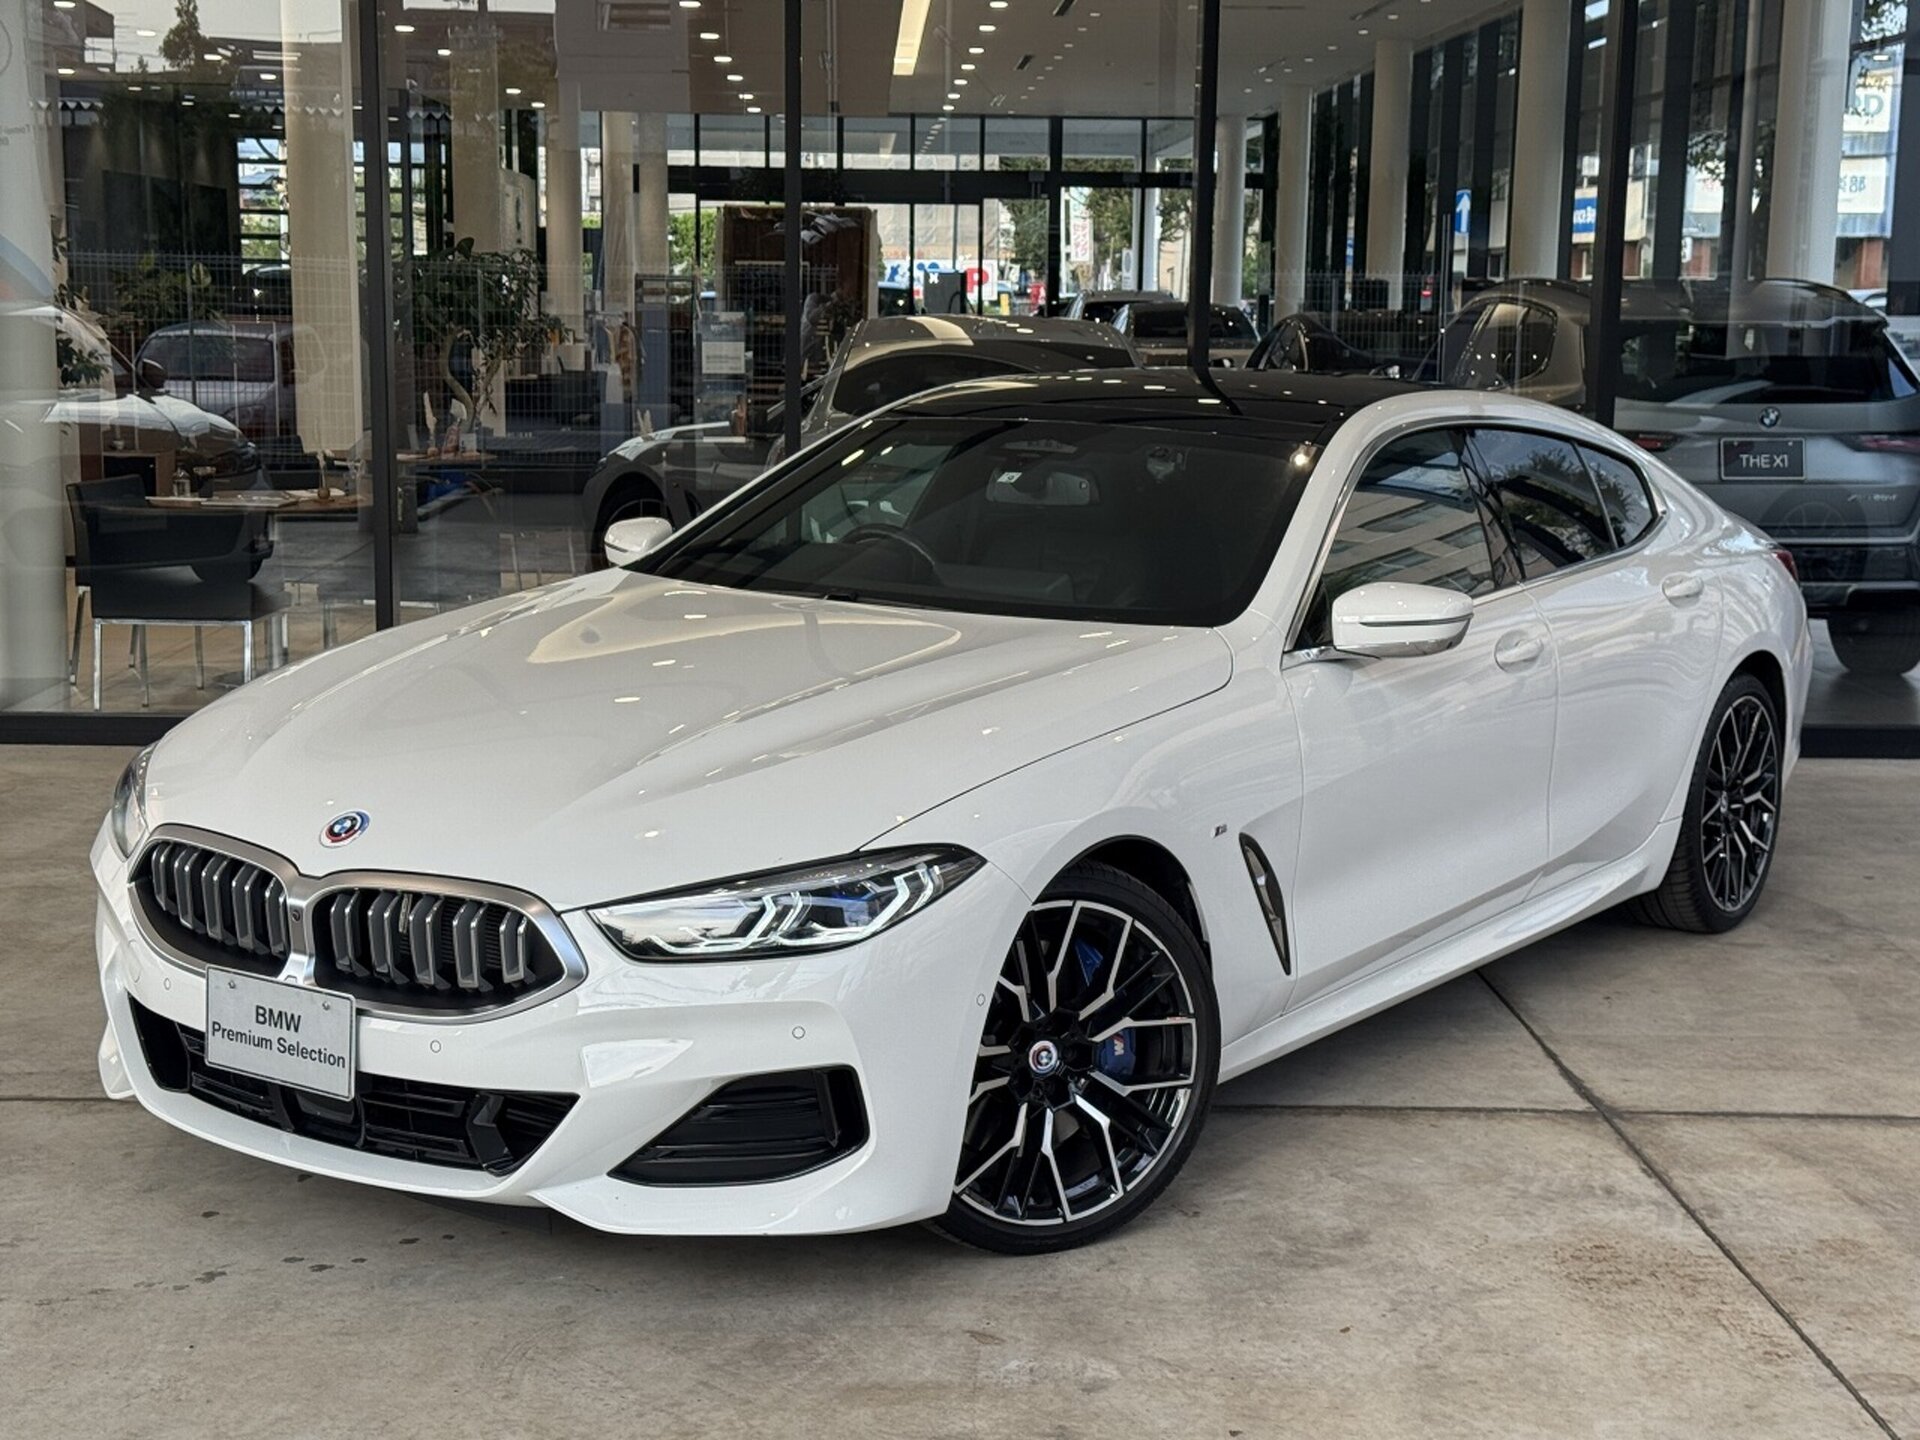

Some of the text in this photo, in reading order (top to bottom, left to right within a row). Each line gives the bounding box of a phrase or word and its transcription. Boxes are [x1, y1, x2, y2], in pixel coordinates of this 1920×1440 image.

[965, 267, 989, 294] P
[1739, 453, 1789, 468] THE X1
[255, 1004, 302, 1033] BMW
[212, 1020, 346, 1069] Premium Selection
